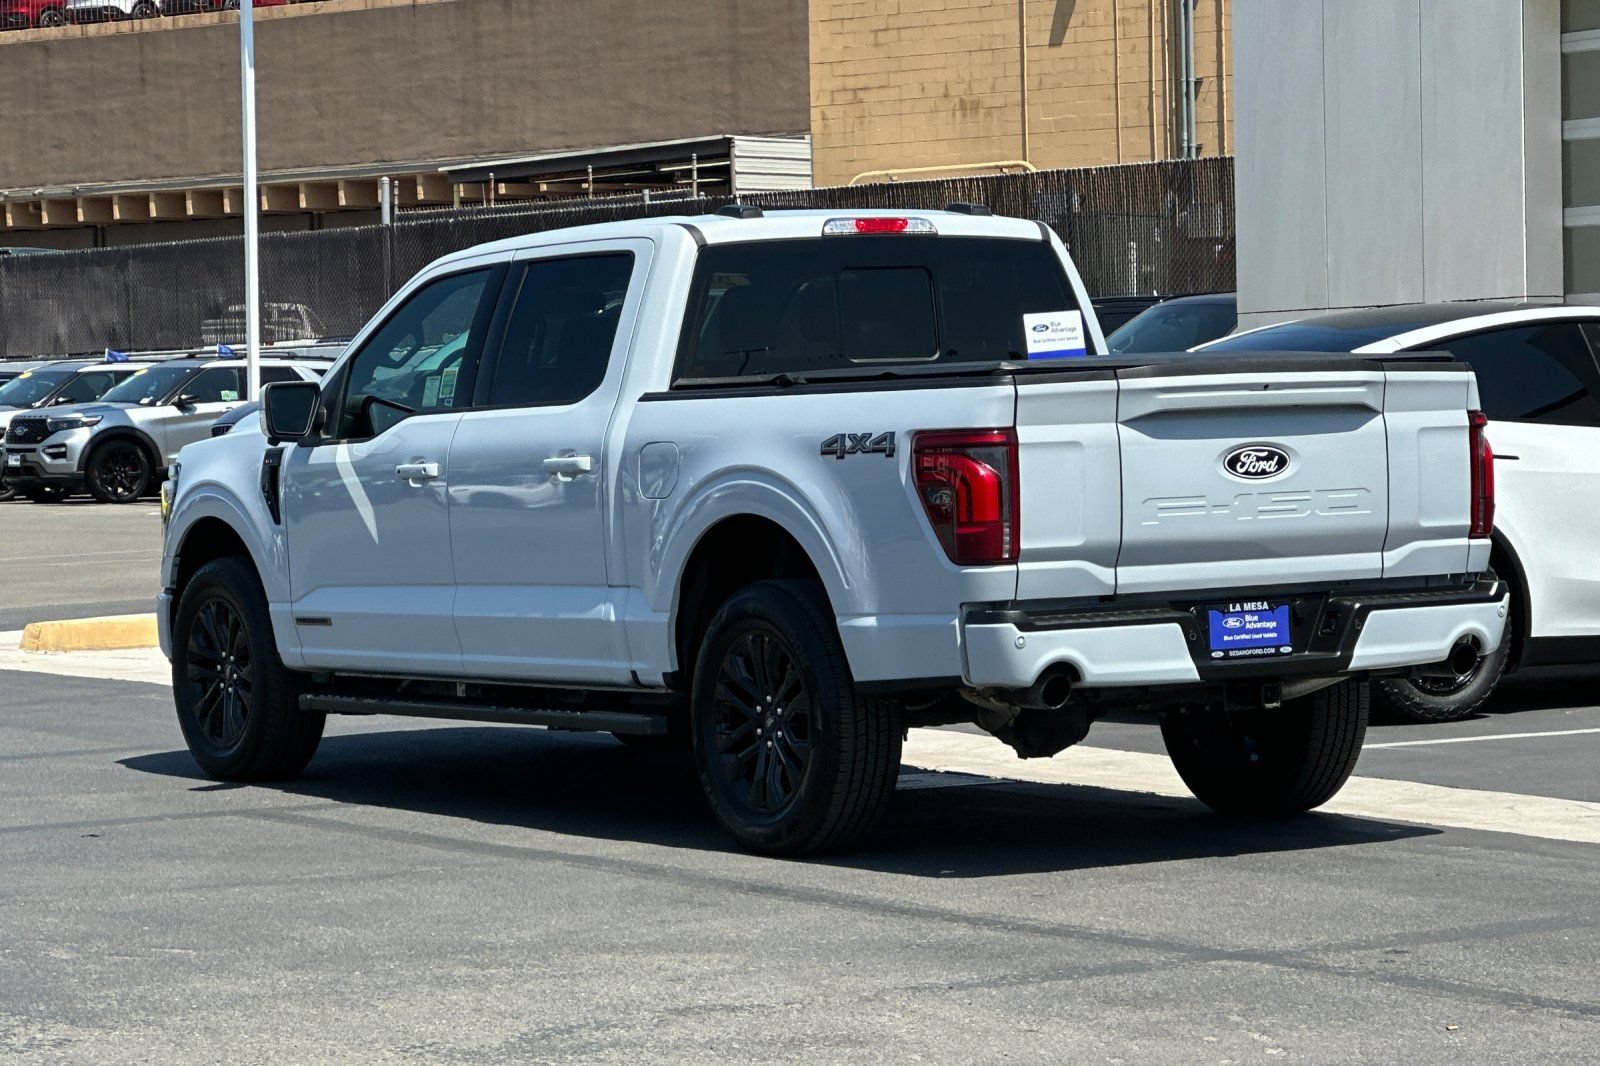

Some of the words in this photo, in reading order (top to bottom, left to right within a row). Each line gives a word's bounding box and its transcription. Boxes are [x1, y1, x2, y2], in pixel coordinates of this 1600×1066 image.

[1236, 450, 1279, 474] Ford
[1142, 486, 1371, 526] F-150
[1229, 603, 1241, 612] LA
[1243, 601, 1269, 611] MESA
[1246, 621, 1276, 629] Advantage
